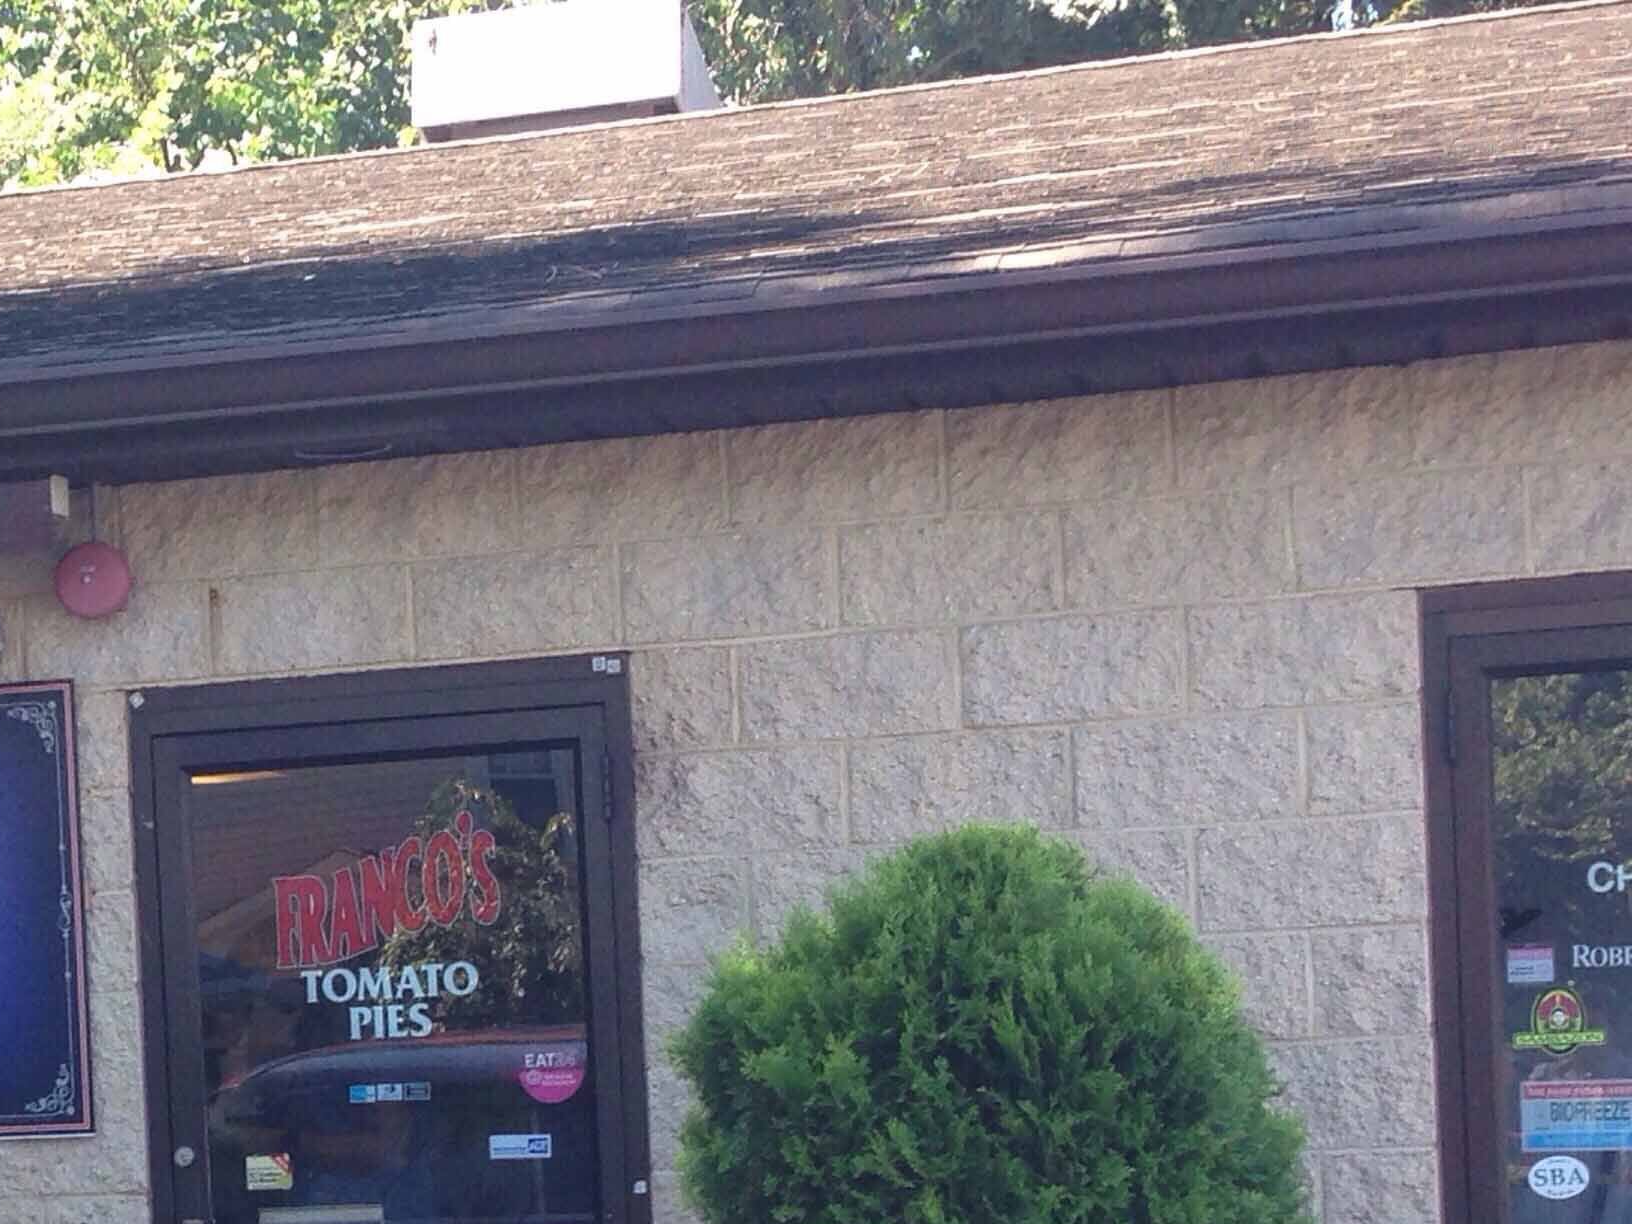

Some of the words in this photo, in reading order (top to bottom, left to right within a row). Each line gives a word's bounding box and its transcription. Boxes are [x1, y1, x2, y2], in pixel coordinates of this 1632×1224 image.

[274, 810, 501, 969] FRANCO'S
[300, 960, 479, 1004] TOMATO
[349, 1003, 433, 1040] PIES
[1533, 1167, 1585, 1187] SBA
